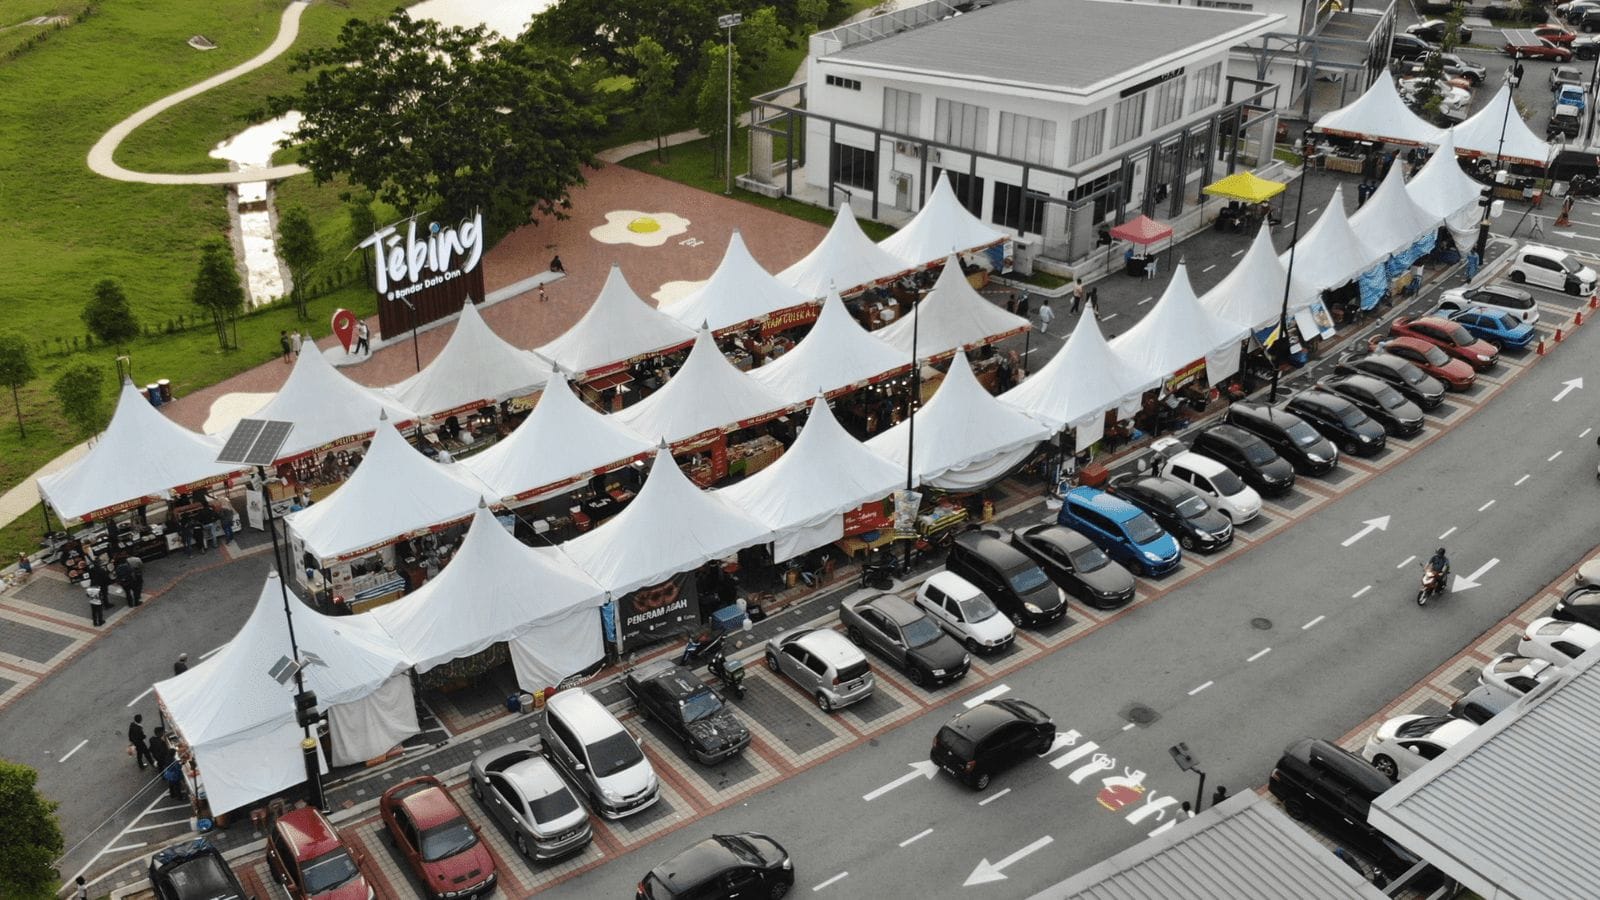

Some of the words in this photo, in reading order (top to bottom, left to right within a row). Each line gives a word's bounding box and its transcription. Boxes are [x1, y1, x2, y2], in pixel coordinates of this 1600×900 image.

[395, 283, 423, 299] Bandar
[424, 276, 443, 288] Dato
[444, 269, 461, 281] Onn
[627, 606, 665, 626] PENERAM
